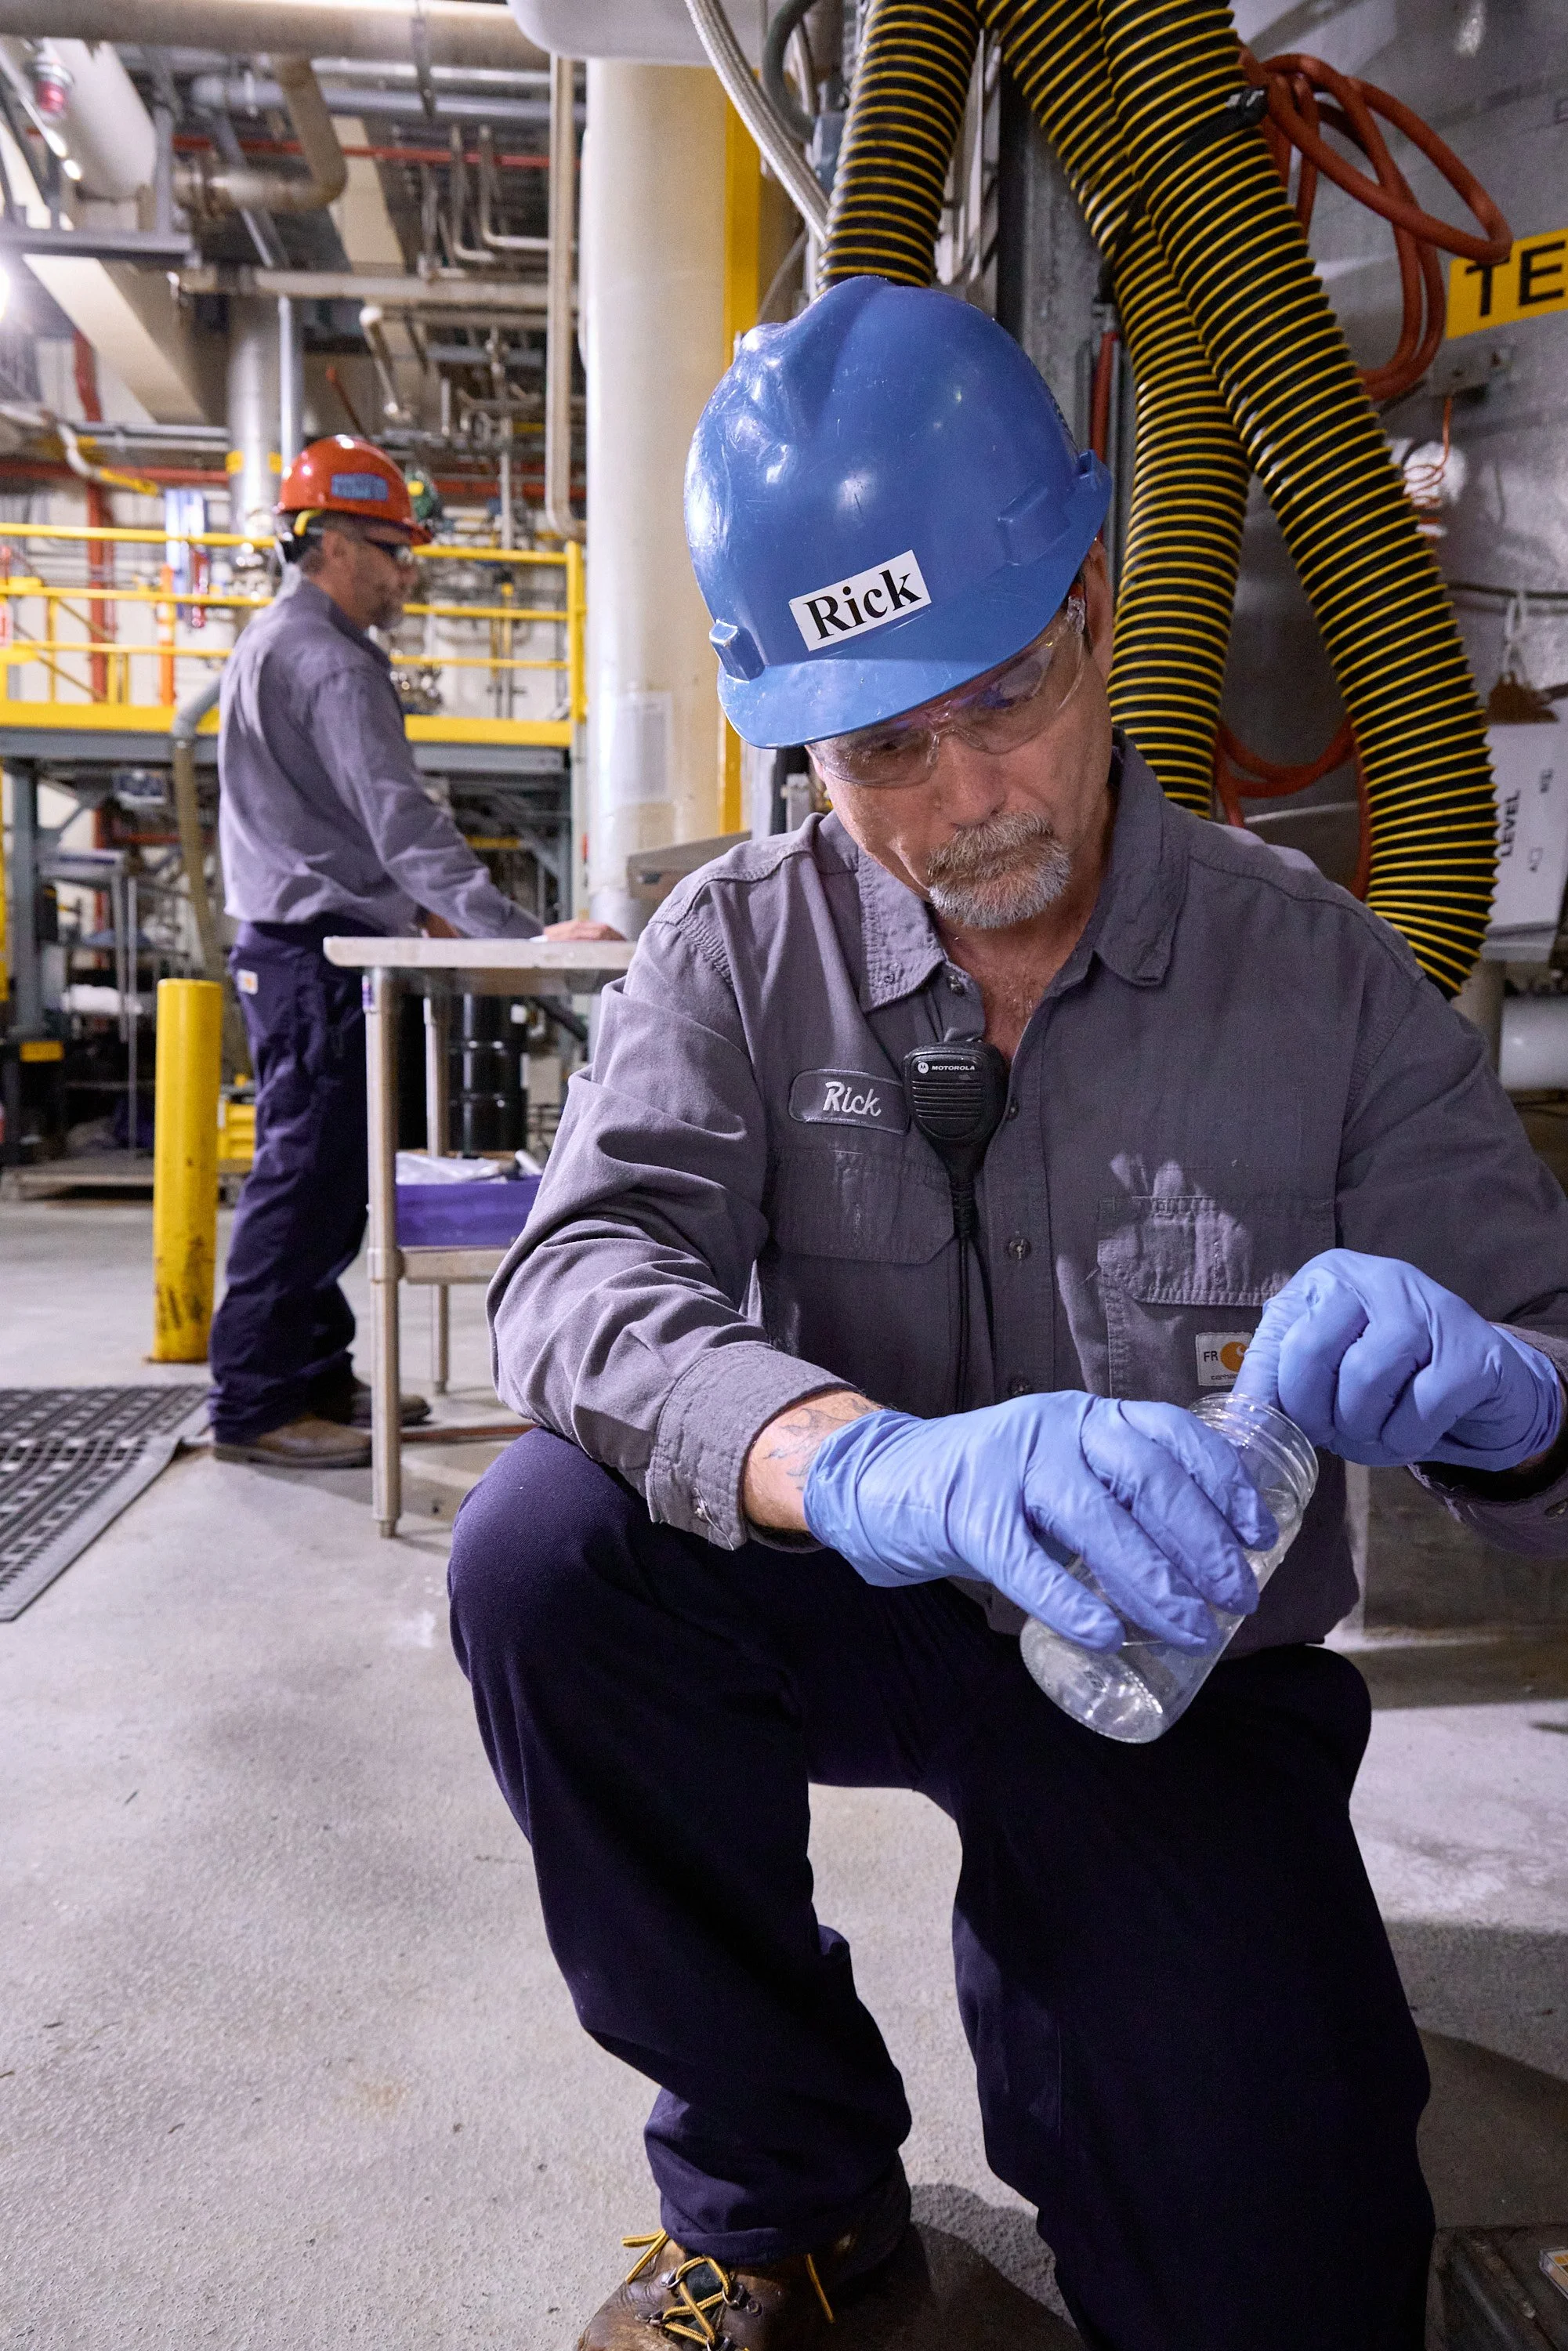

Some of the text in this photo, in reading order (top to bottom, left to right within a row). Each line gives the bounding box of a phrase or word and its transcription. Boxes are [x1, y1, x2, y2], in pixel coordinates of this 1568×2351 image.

[802, 569, 922, 640] Rick
[1501, 789, 1521, 857] LEVEL
[823, 1081, 882, 1117] Rick
[1203, 1350, 1219, 1362] FR
